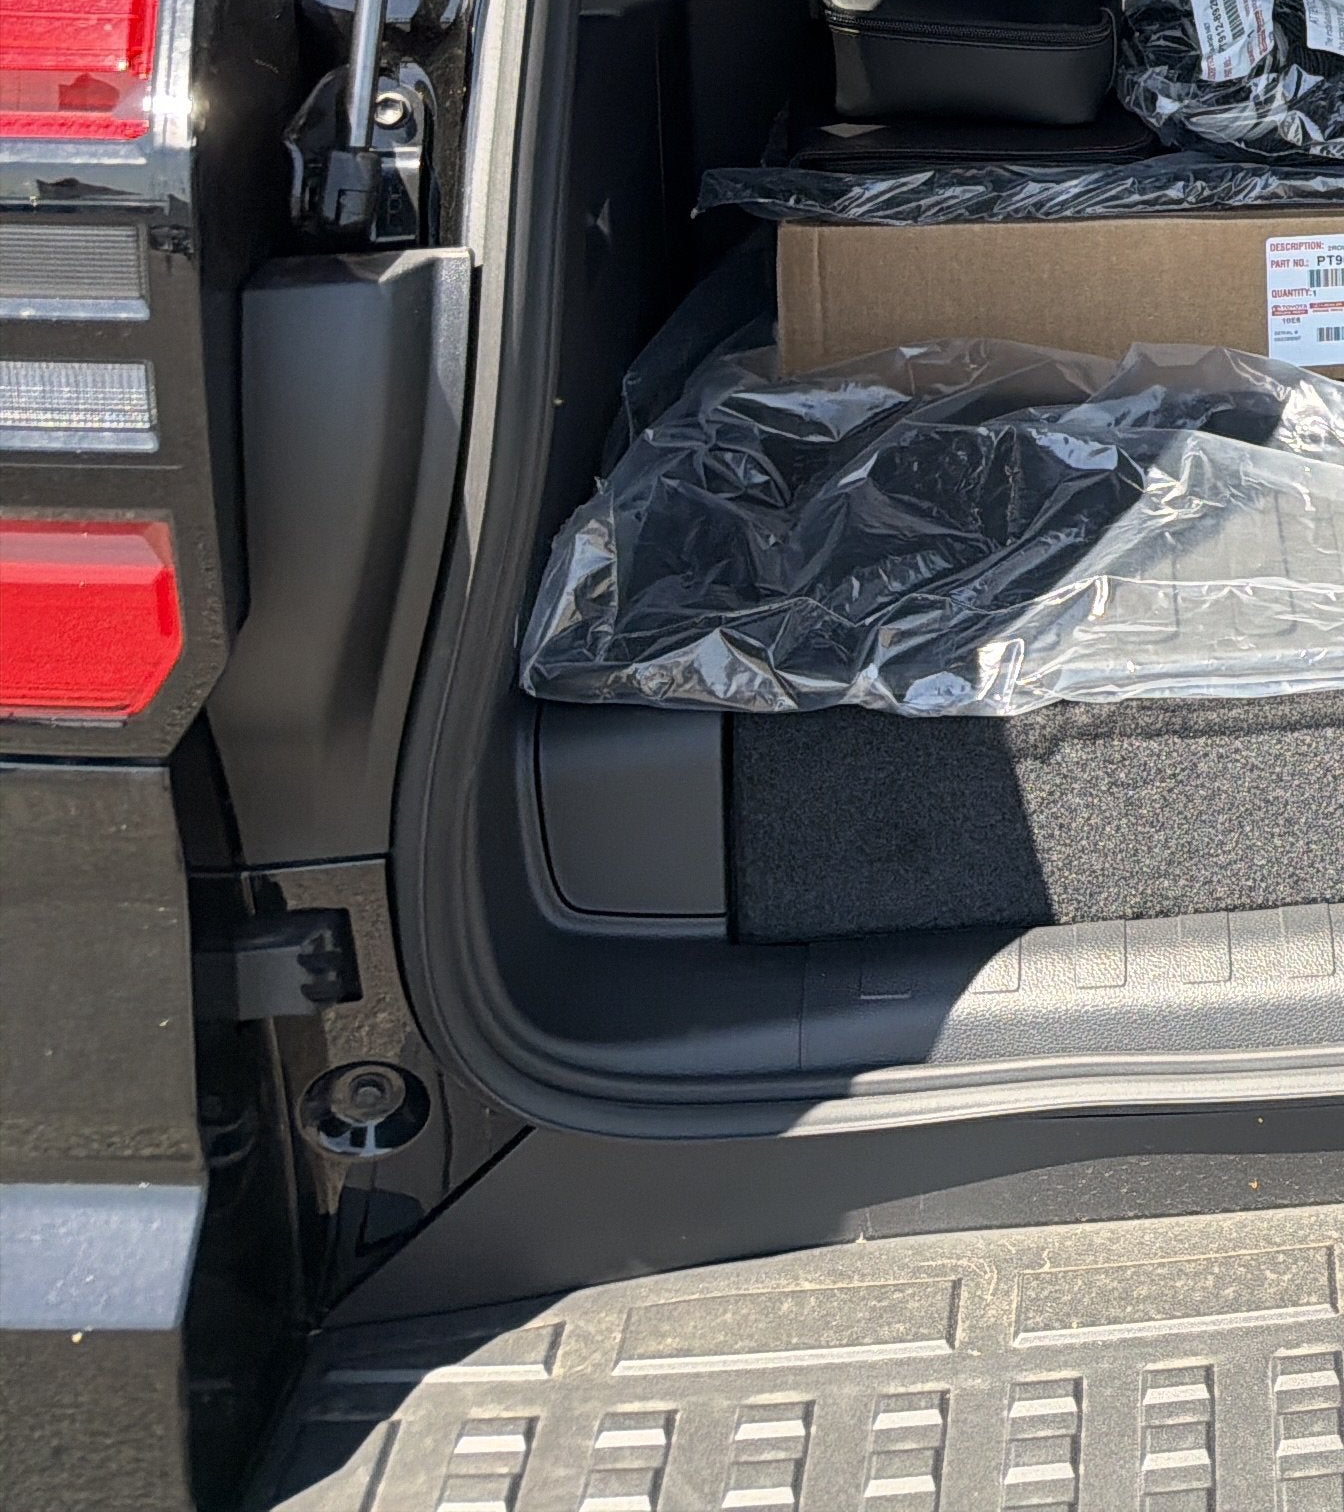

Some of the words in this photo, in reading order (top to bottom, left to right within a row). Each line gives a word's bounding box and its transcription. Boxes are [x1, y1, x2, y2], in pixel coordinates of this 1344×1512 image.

[1269, 240, 1325, 252] DESCRIPTION:
[1270, 259, 1291, 269] PART
[1292, 258, 1310, 268] NO.:
[1271, 288, 1312, 299] QUANTITY:
